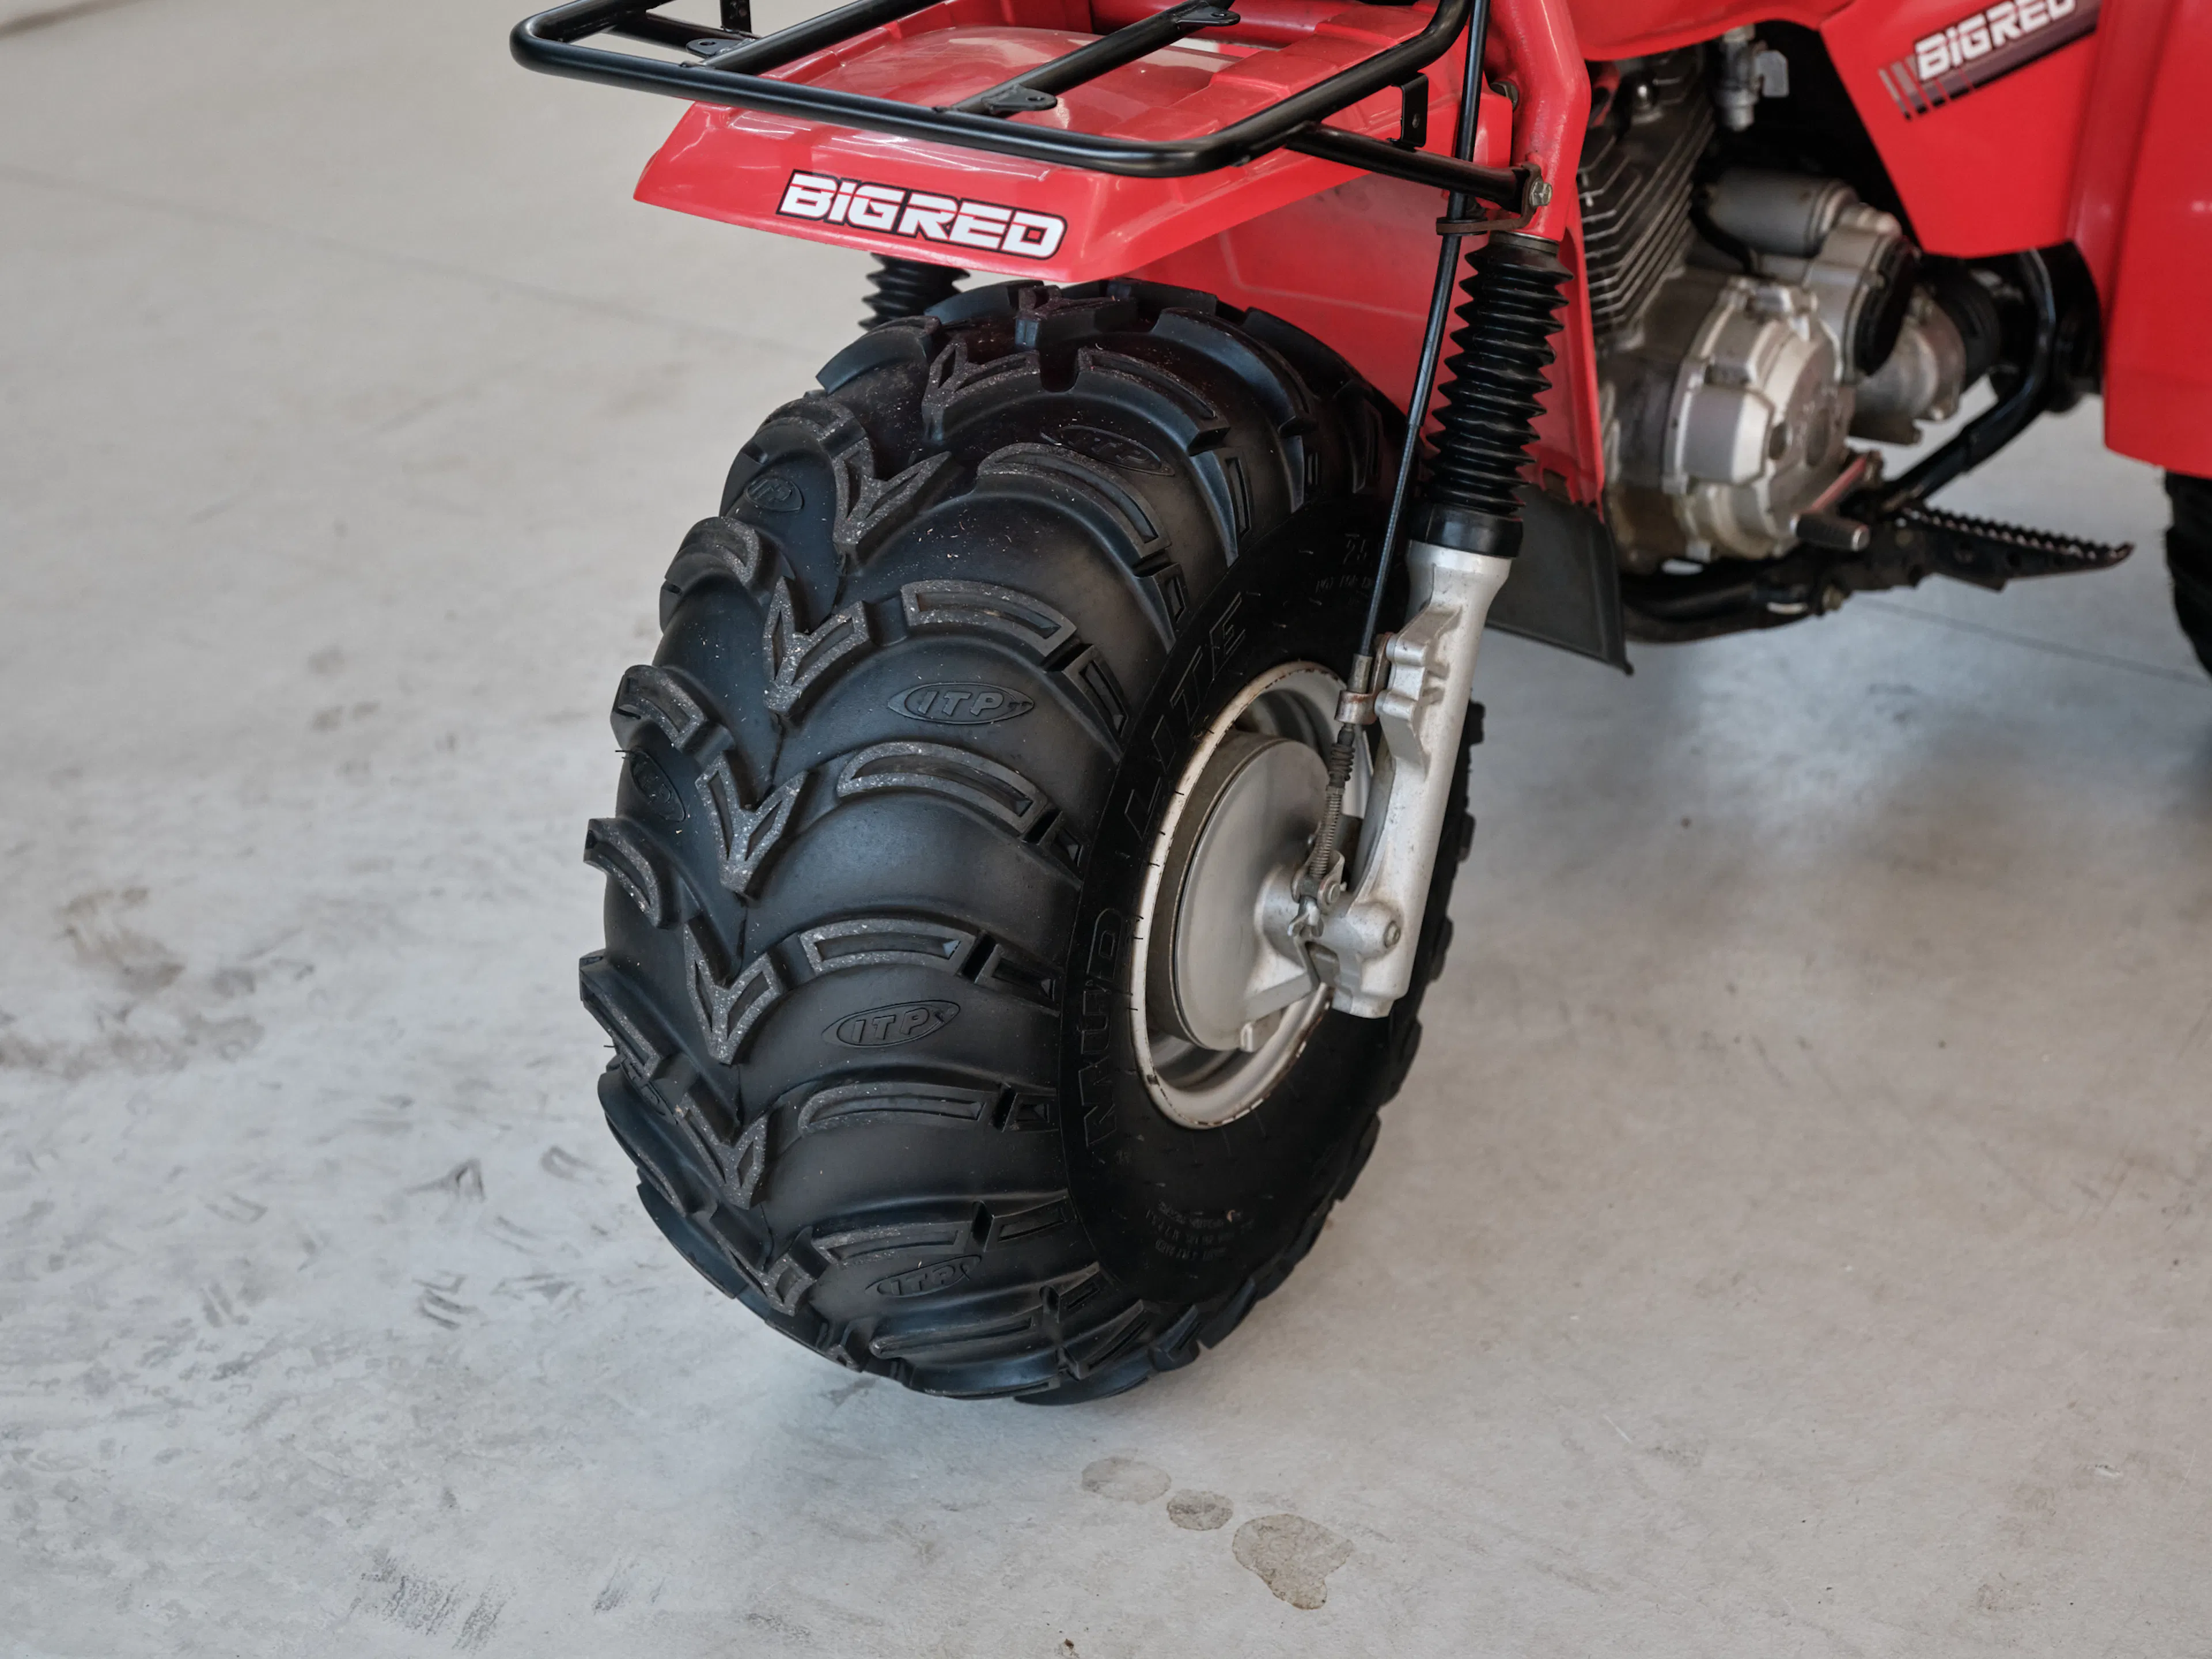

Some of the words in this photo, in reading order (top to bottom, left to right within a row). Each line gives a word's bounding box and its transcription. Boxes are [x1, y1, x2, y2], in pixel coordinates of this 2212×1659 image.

[778, 171, 1067, 260] BIGRED
[917, 691, 1005, 716] ITP
[1080, 908, 1123, 1147] MUD
[1124, 591, 1246, 842] LITE
[854, 1006, 932, 1043] ITP
[890, 1264, 956, 1296] ITP
